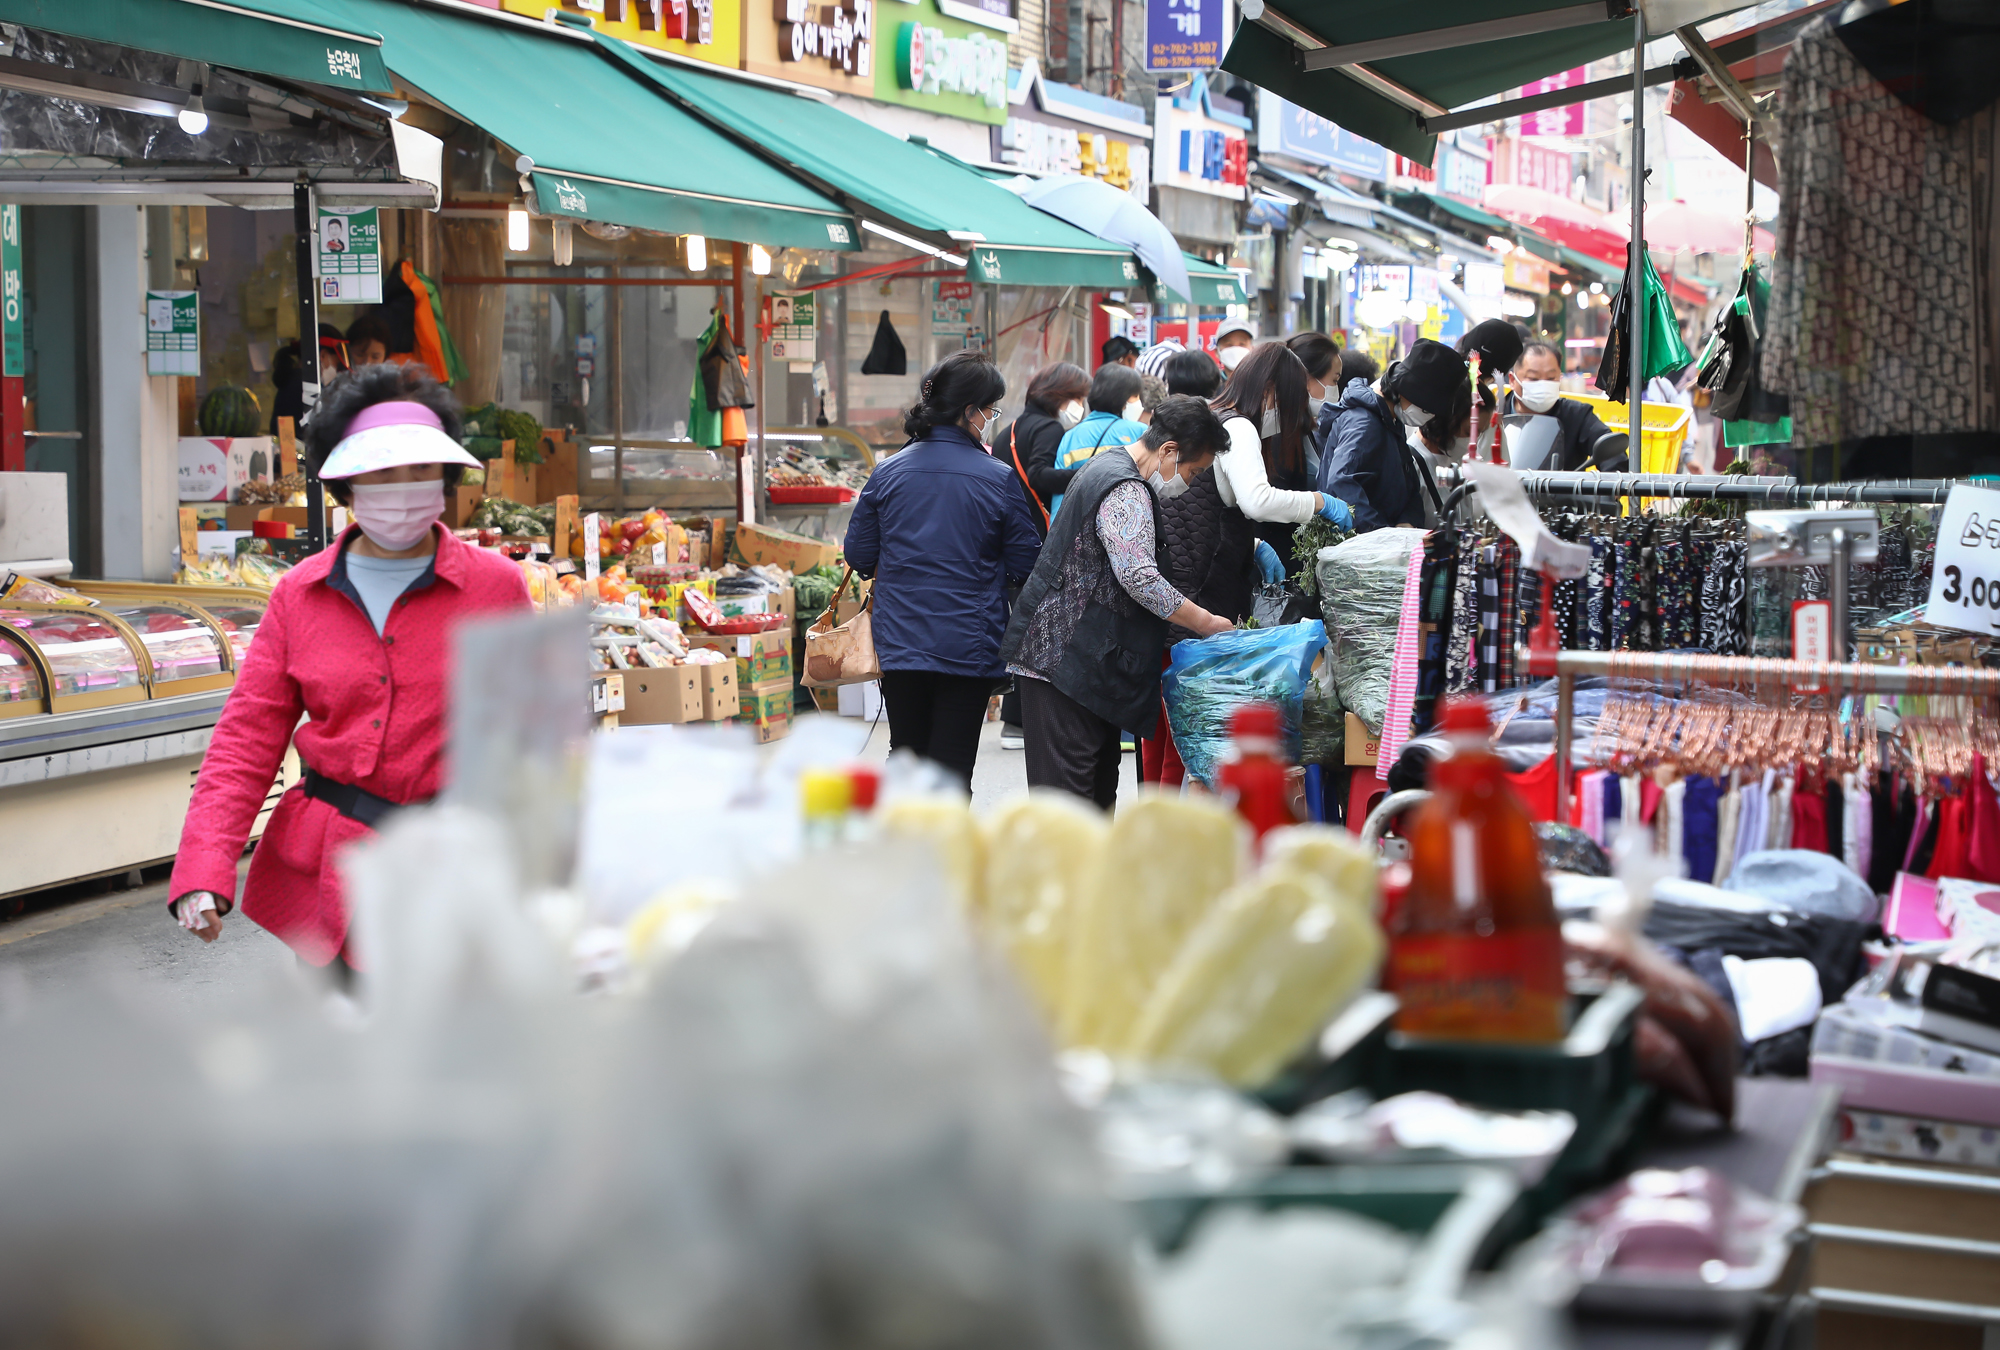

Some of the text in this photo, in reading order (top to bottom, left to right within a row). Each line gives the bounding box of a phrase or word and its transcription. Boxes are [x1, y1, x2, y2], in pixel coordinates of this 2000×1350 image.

[1152, 41, 1218, 55] 02-702-3307
[349, 224, 377, 236] C-16
[173, 307, 196, 318] C-15
[1364, 742, 1379, 757] 완
